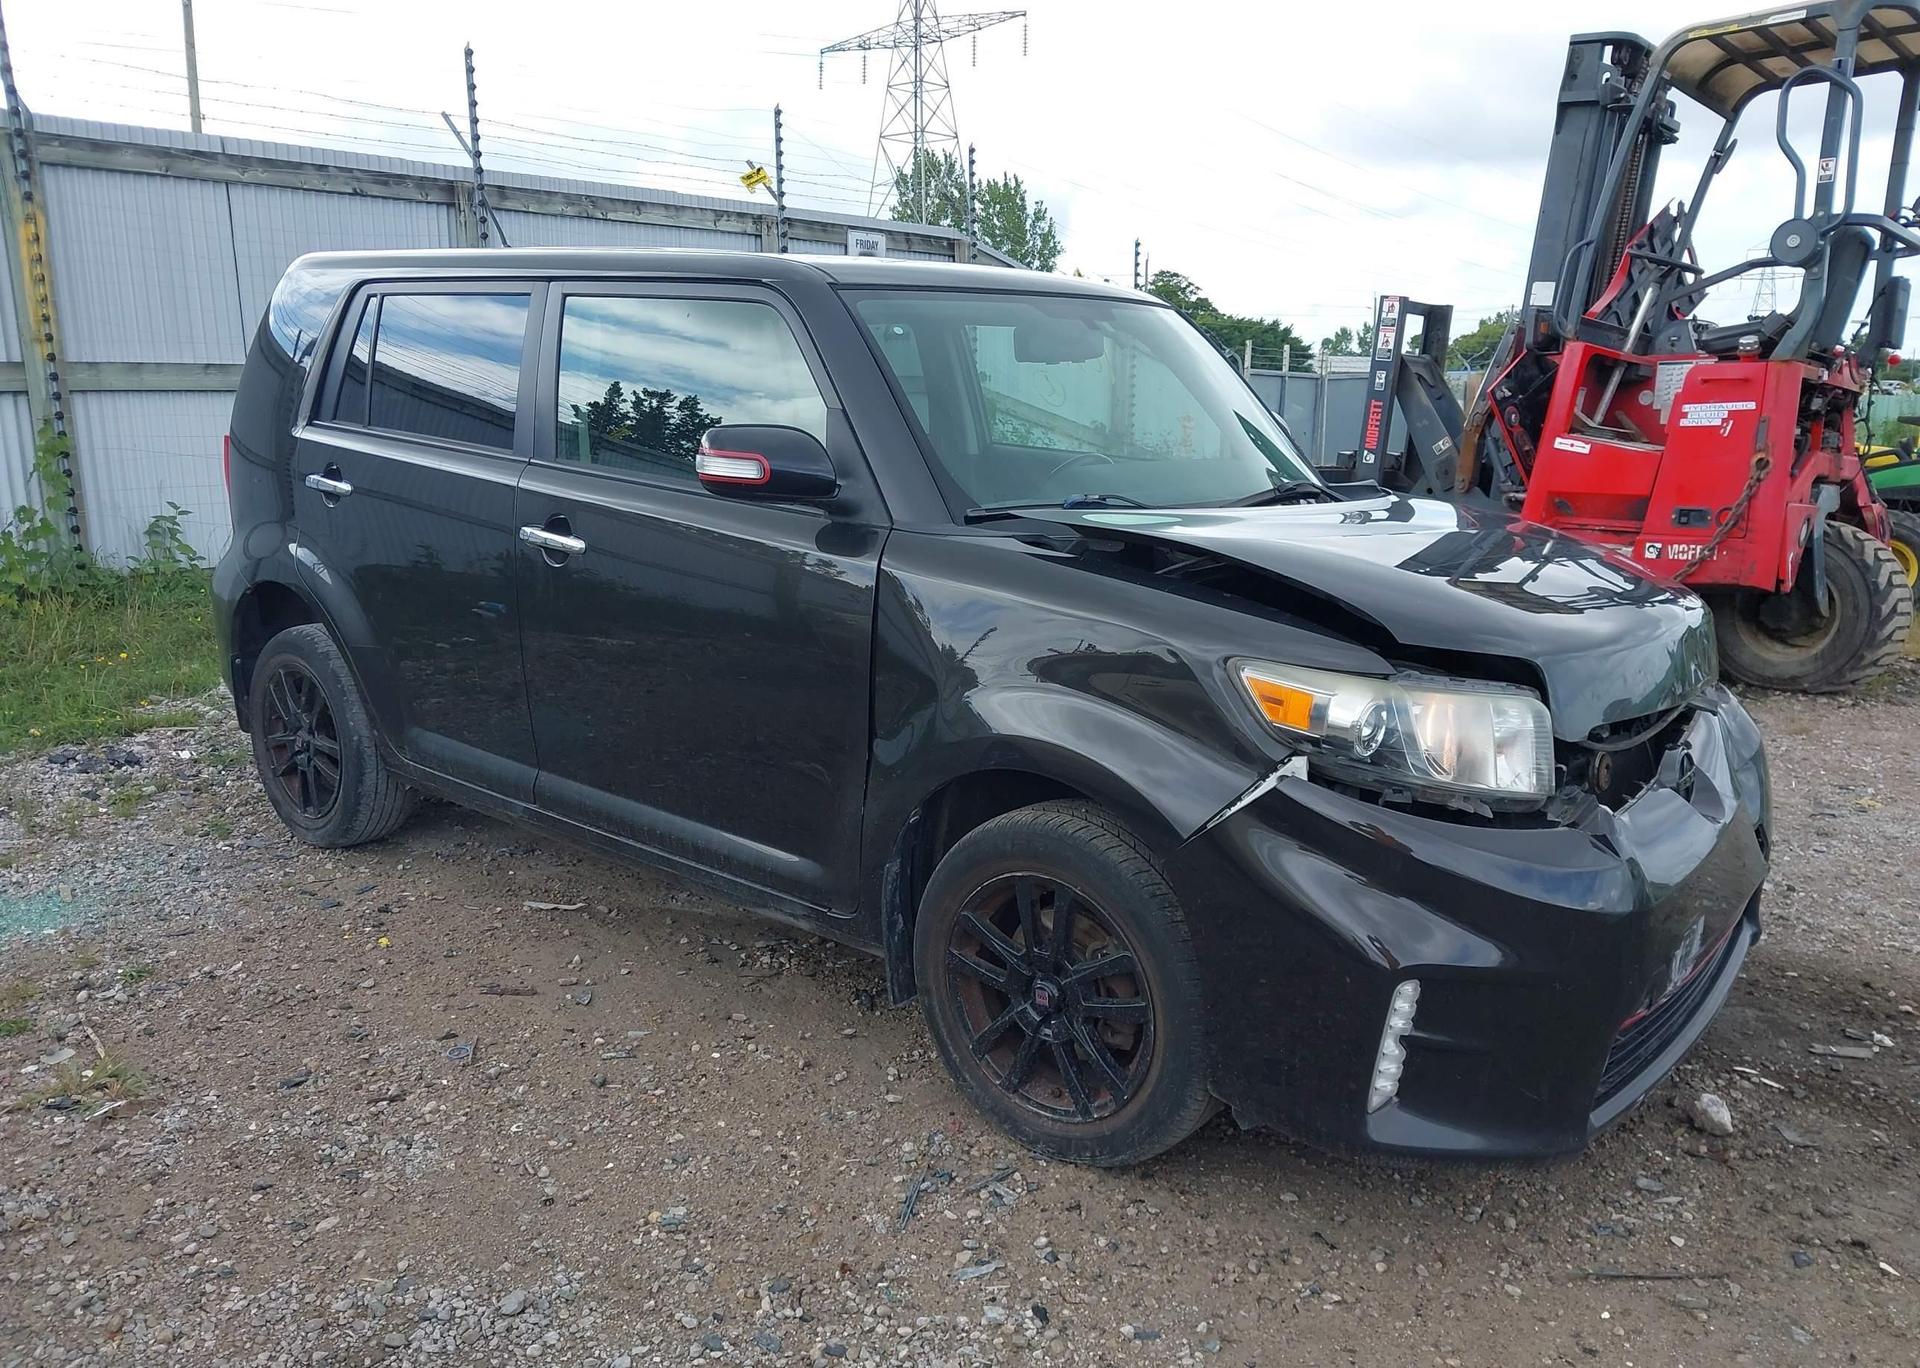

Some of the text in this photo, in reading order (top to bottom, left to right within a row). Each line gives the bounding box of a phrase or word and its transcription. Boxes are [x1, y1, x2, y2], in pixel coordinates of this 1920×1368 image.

[855, 238, 879, 251] FRIDAY
[1365, 399, 1384, 450] MOFFETT
[1667, 543, 1718, 561] MOFF
